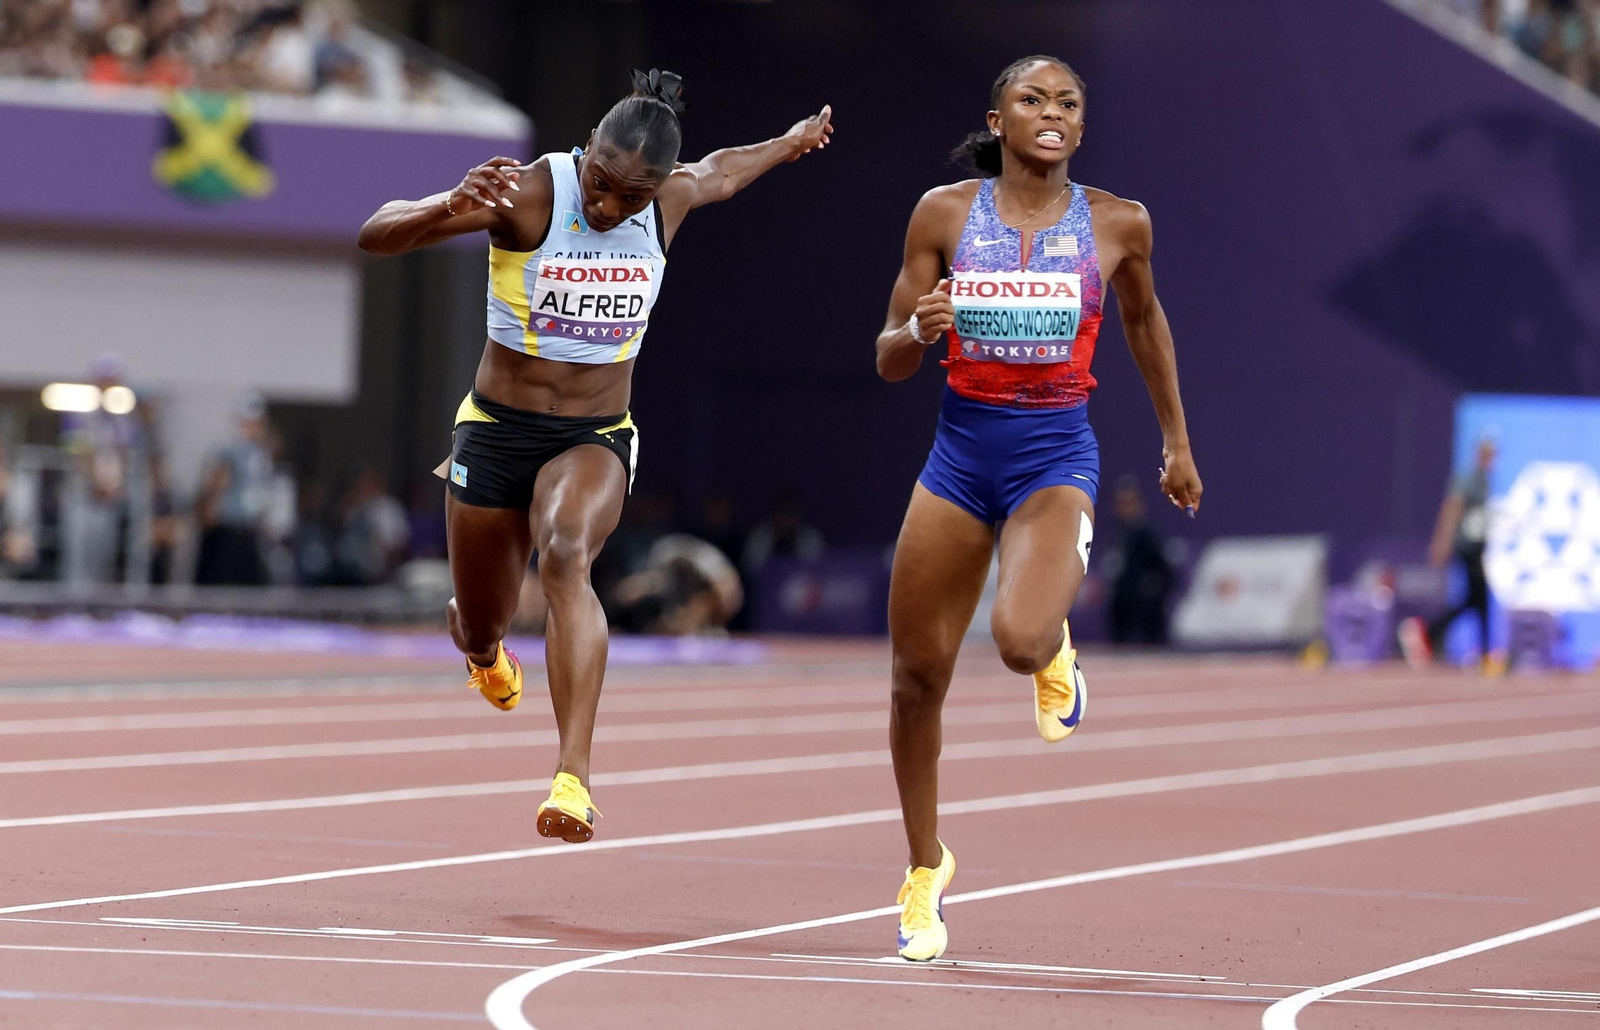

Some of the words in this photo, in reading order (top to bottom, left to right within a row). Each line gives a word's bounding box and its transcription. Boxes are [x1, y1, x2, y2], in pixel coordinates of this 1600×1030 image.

[540, 265, 649, 282] HONDA
[954, 280, 1077, 298] HONDA
[538, 291, 643, 319] ALFRED
[956, 309, 1077, 337] JEFFERSON-WOODEN
